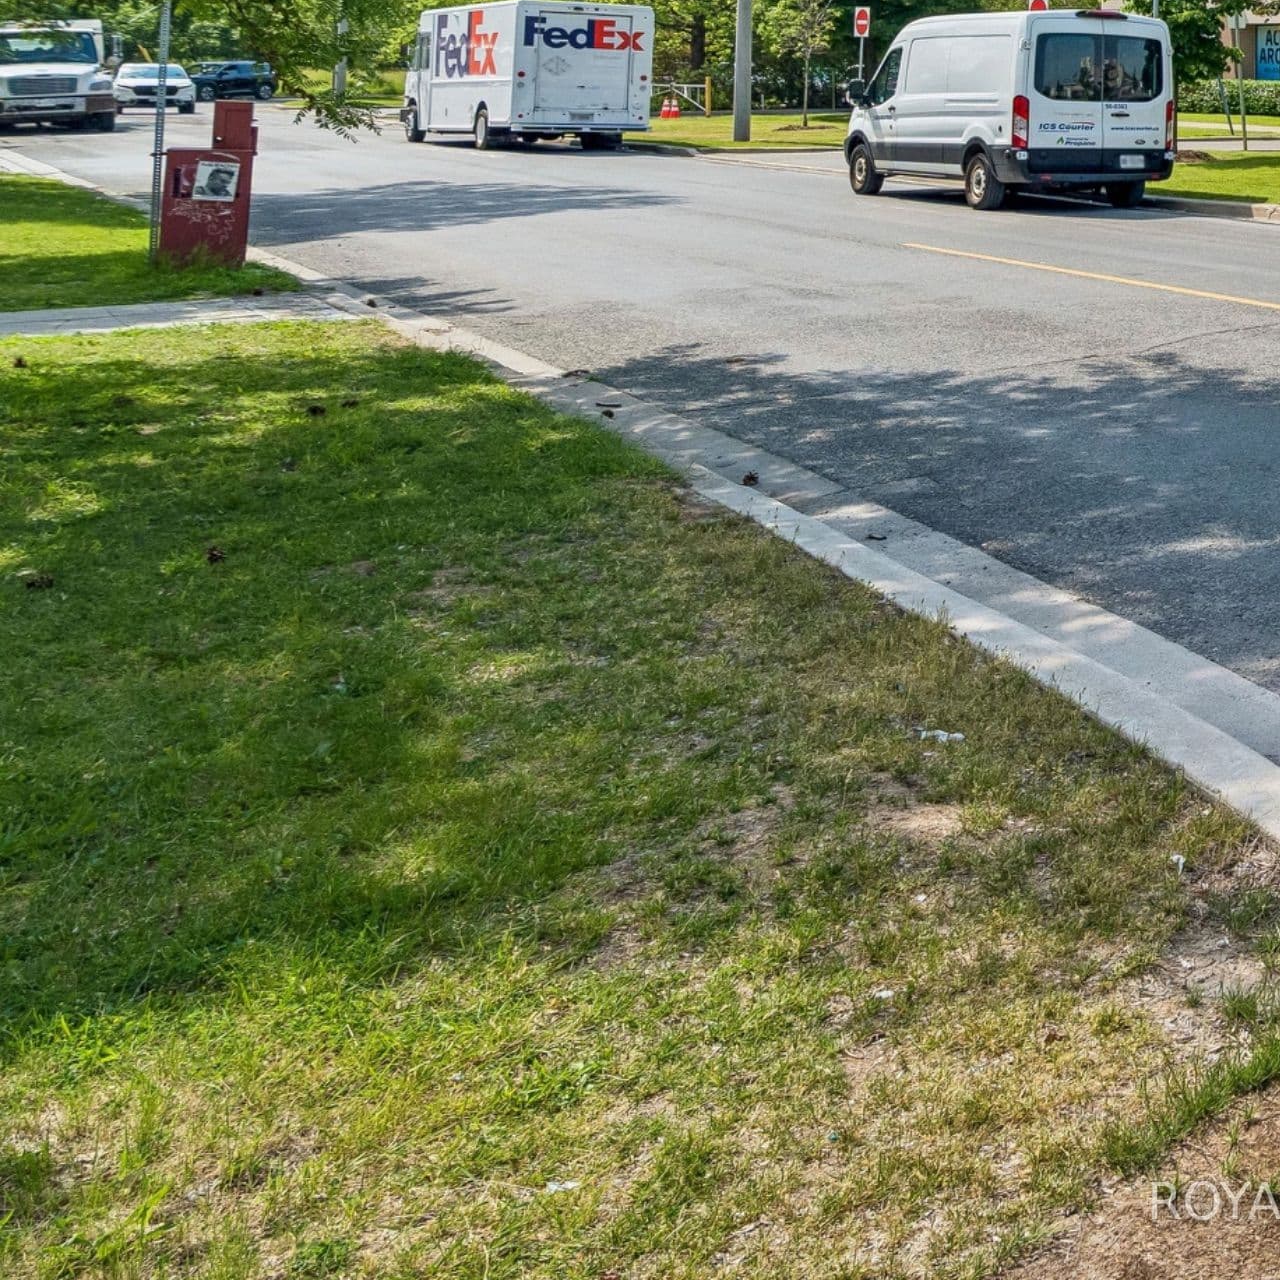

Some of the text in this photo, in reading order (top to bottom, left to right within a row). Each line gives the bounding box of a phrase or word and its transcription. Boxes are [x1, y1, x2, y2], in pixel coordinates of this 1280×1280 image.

[435, 10, 499, 78] FedEx
[523, 15, 645, 52] FedEx
[1058, 123, 1094, 131] Courier
